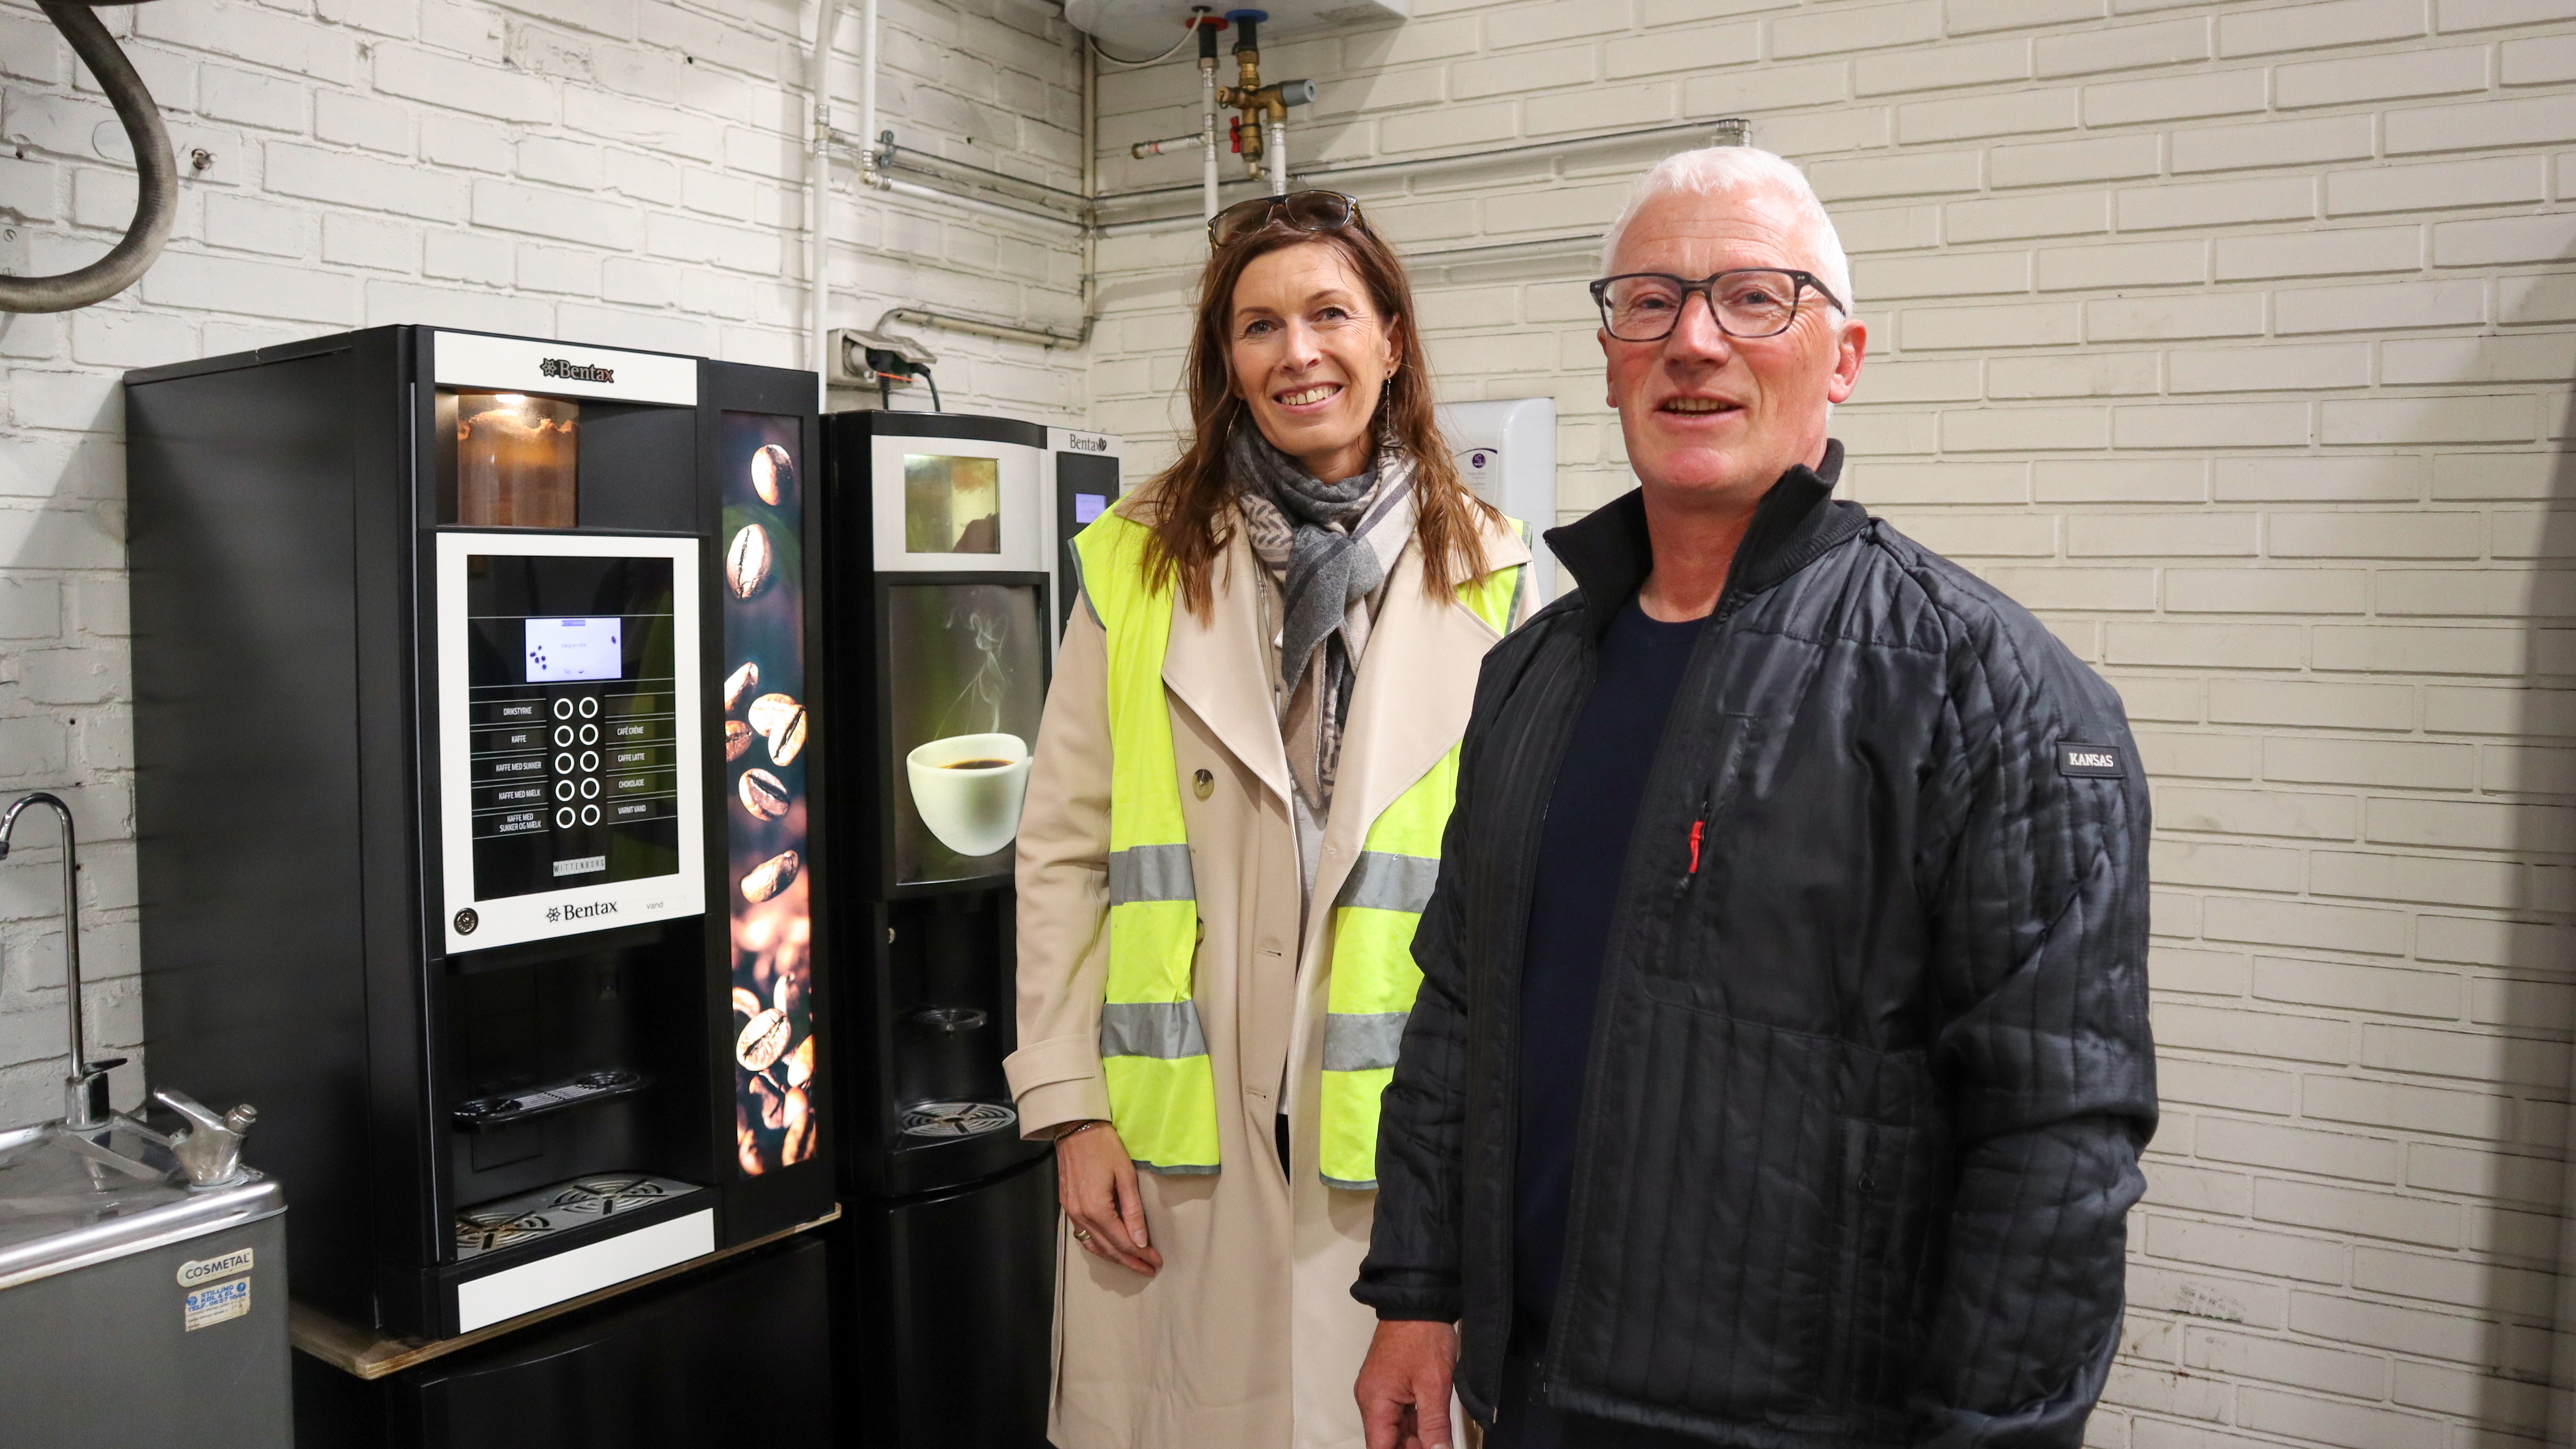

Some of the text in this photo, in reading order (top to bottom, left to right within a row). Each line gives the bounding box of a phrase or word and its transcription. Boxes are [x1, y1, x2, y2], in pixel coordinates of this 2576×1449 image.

[558, 360, 614, 383] Bentax
[1070, 434, 1100, 452] Bentax
[503, 707, 532, 716] DRIKSTYRKE
[617, 726, 628, 735] CAFÉ
[511, 735, 526, 743] KAFFE
[632, 753, 645, 761] LATTE
[2069, 752, 2114, 767] KANSAS
[523, 762, 541, 770] SUKKER
[618, 779, 644, 788] CHOKOLADE
[499, 789, 541, 800] KAFFE MED MÆLK
[618, 806, 633, 815] VARMT
[507, 814, 522, 823] KAFFE
[499, 823, 519, 833] SUKKER
[527, 821, 541, 829] MÆLK
[553, 859, 604, 872] WITTENBORG
[563, 901, 617, 920] Bentax
[186, 1254, 249, 1279] COSMETAL
[201, 1285, 233, 1298] STILLING
